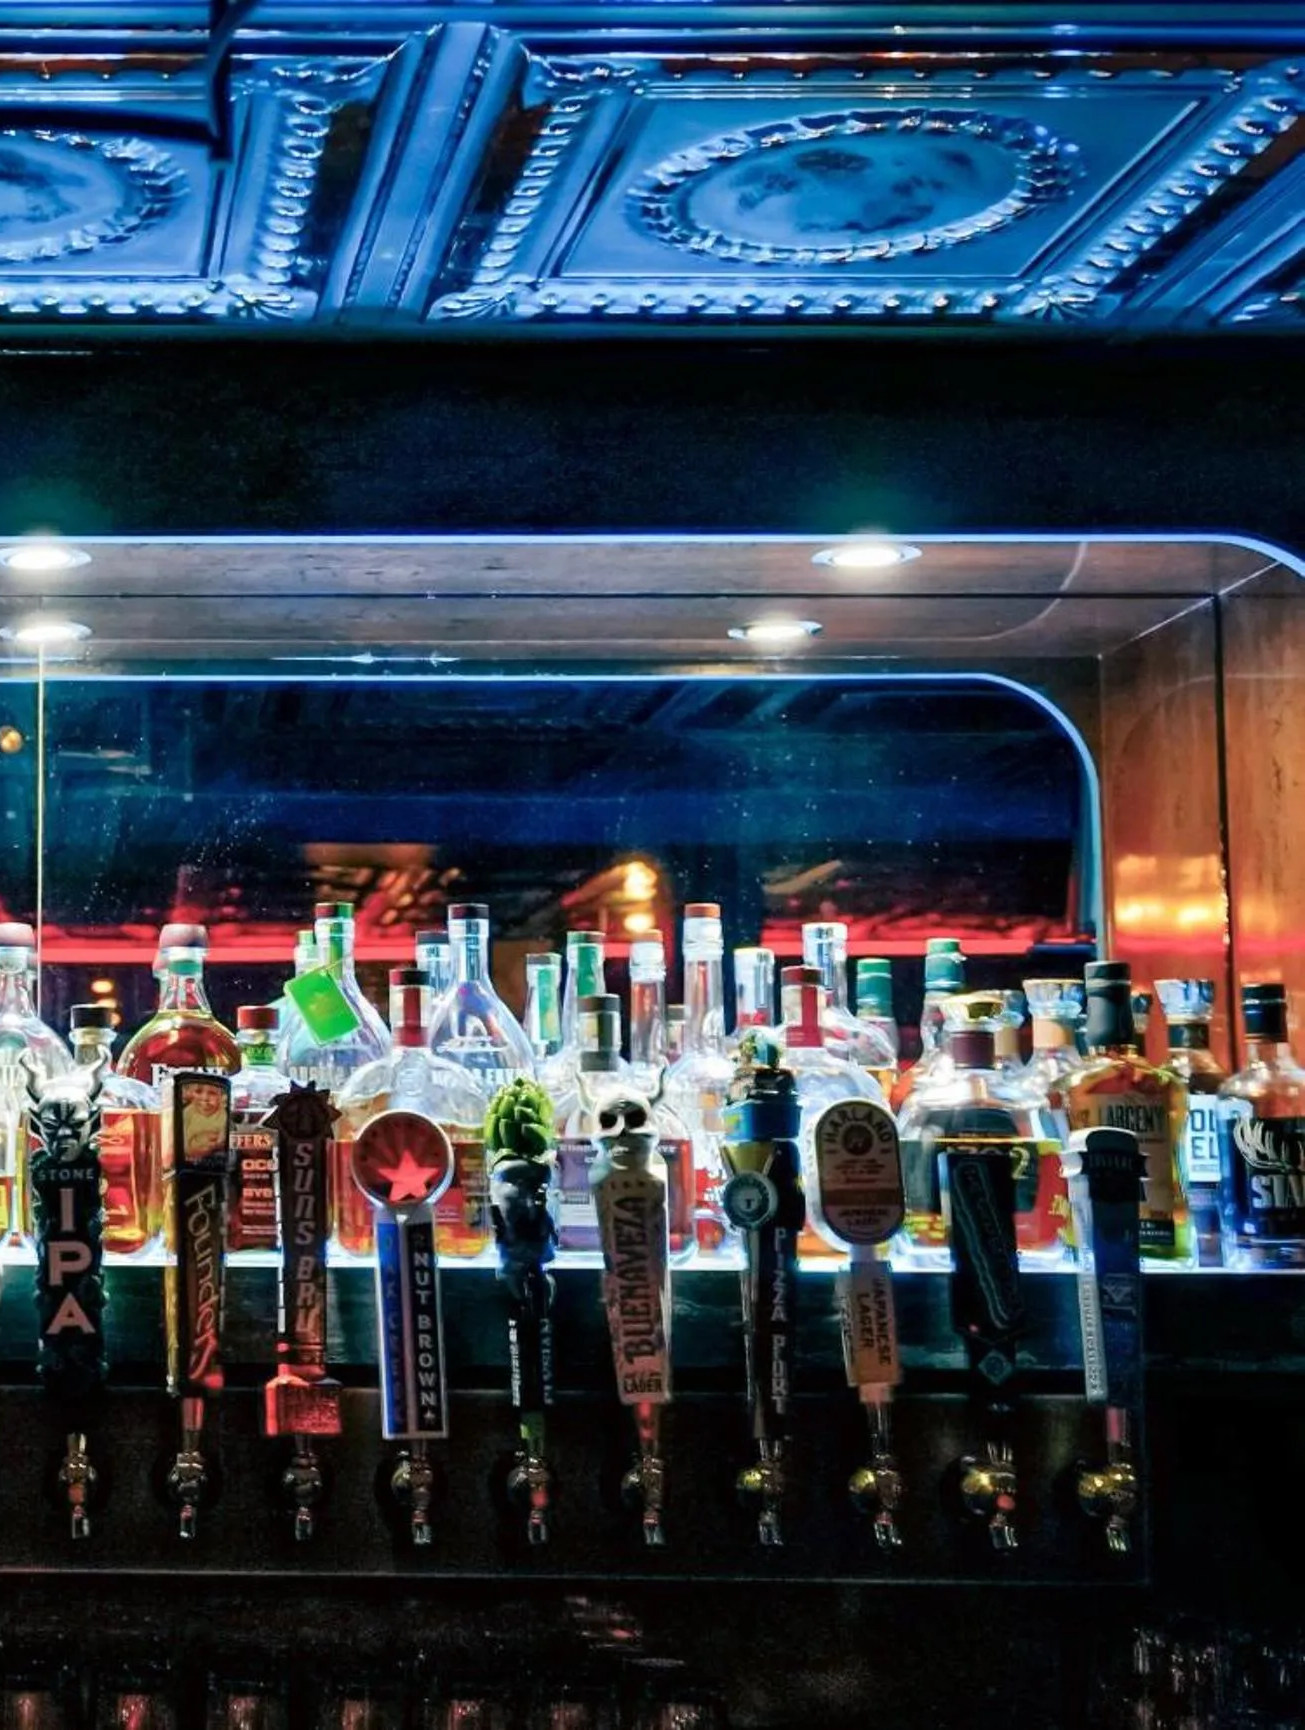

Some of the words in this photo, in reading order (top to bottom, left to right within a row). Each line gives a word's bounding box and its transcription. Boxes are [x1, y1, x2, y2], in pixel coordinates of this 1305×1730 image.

[824, 1108, 893, 1142] HARLAND
[1191, 1109, 1217, 1132] OL
[1192, 1136, 1218, 1159] EL
[37, 1168, 95, 1182] STONE
[45, 1187, 97, 1335] IPA
[412, 1252, 434, 1305] NUT
[769, 1227, 788, 1323] PIZZA
[417, 1315, 439, 1407] BROWN
[770, 1334, 791, 1416] PORT
